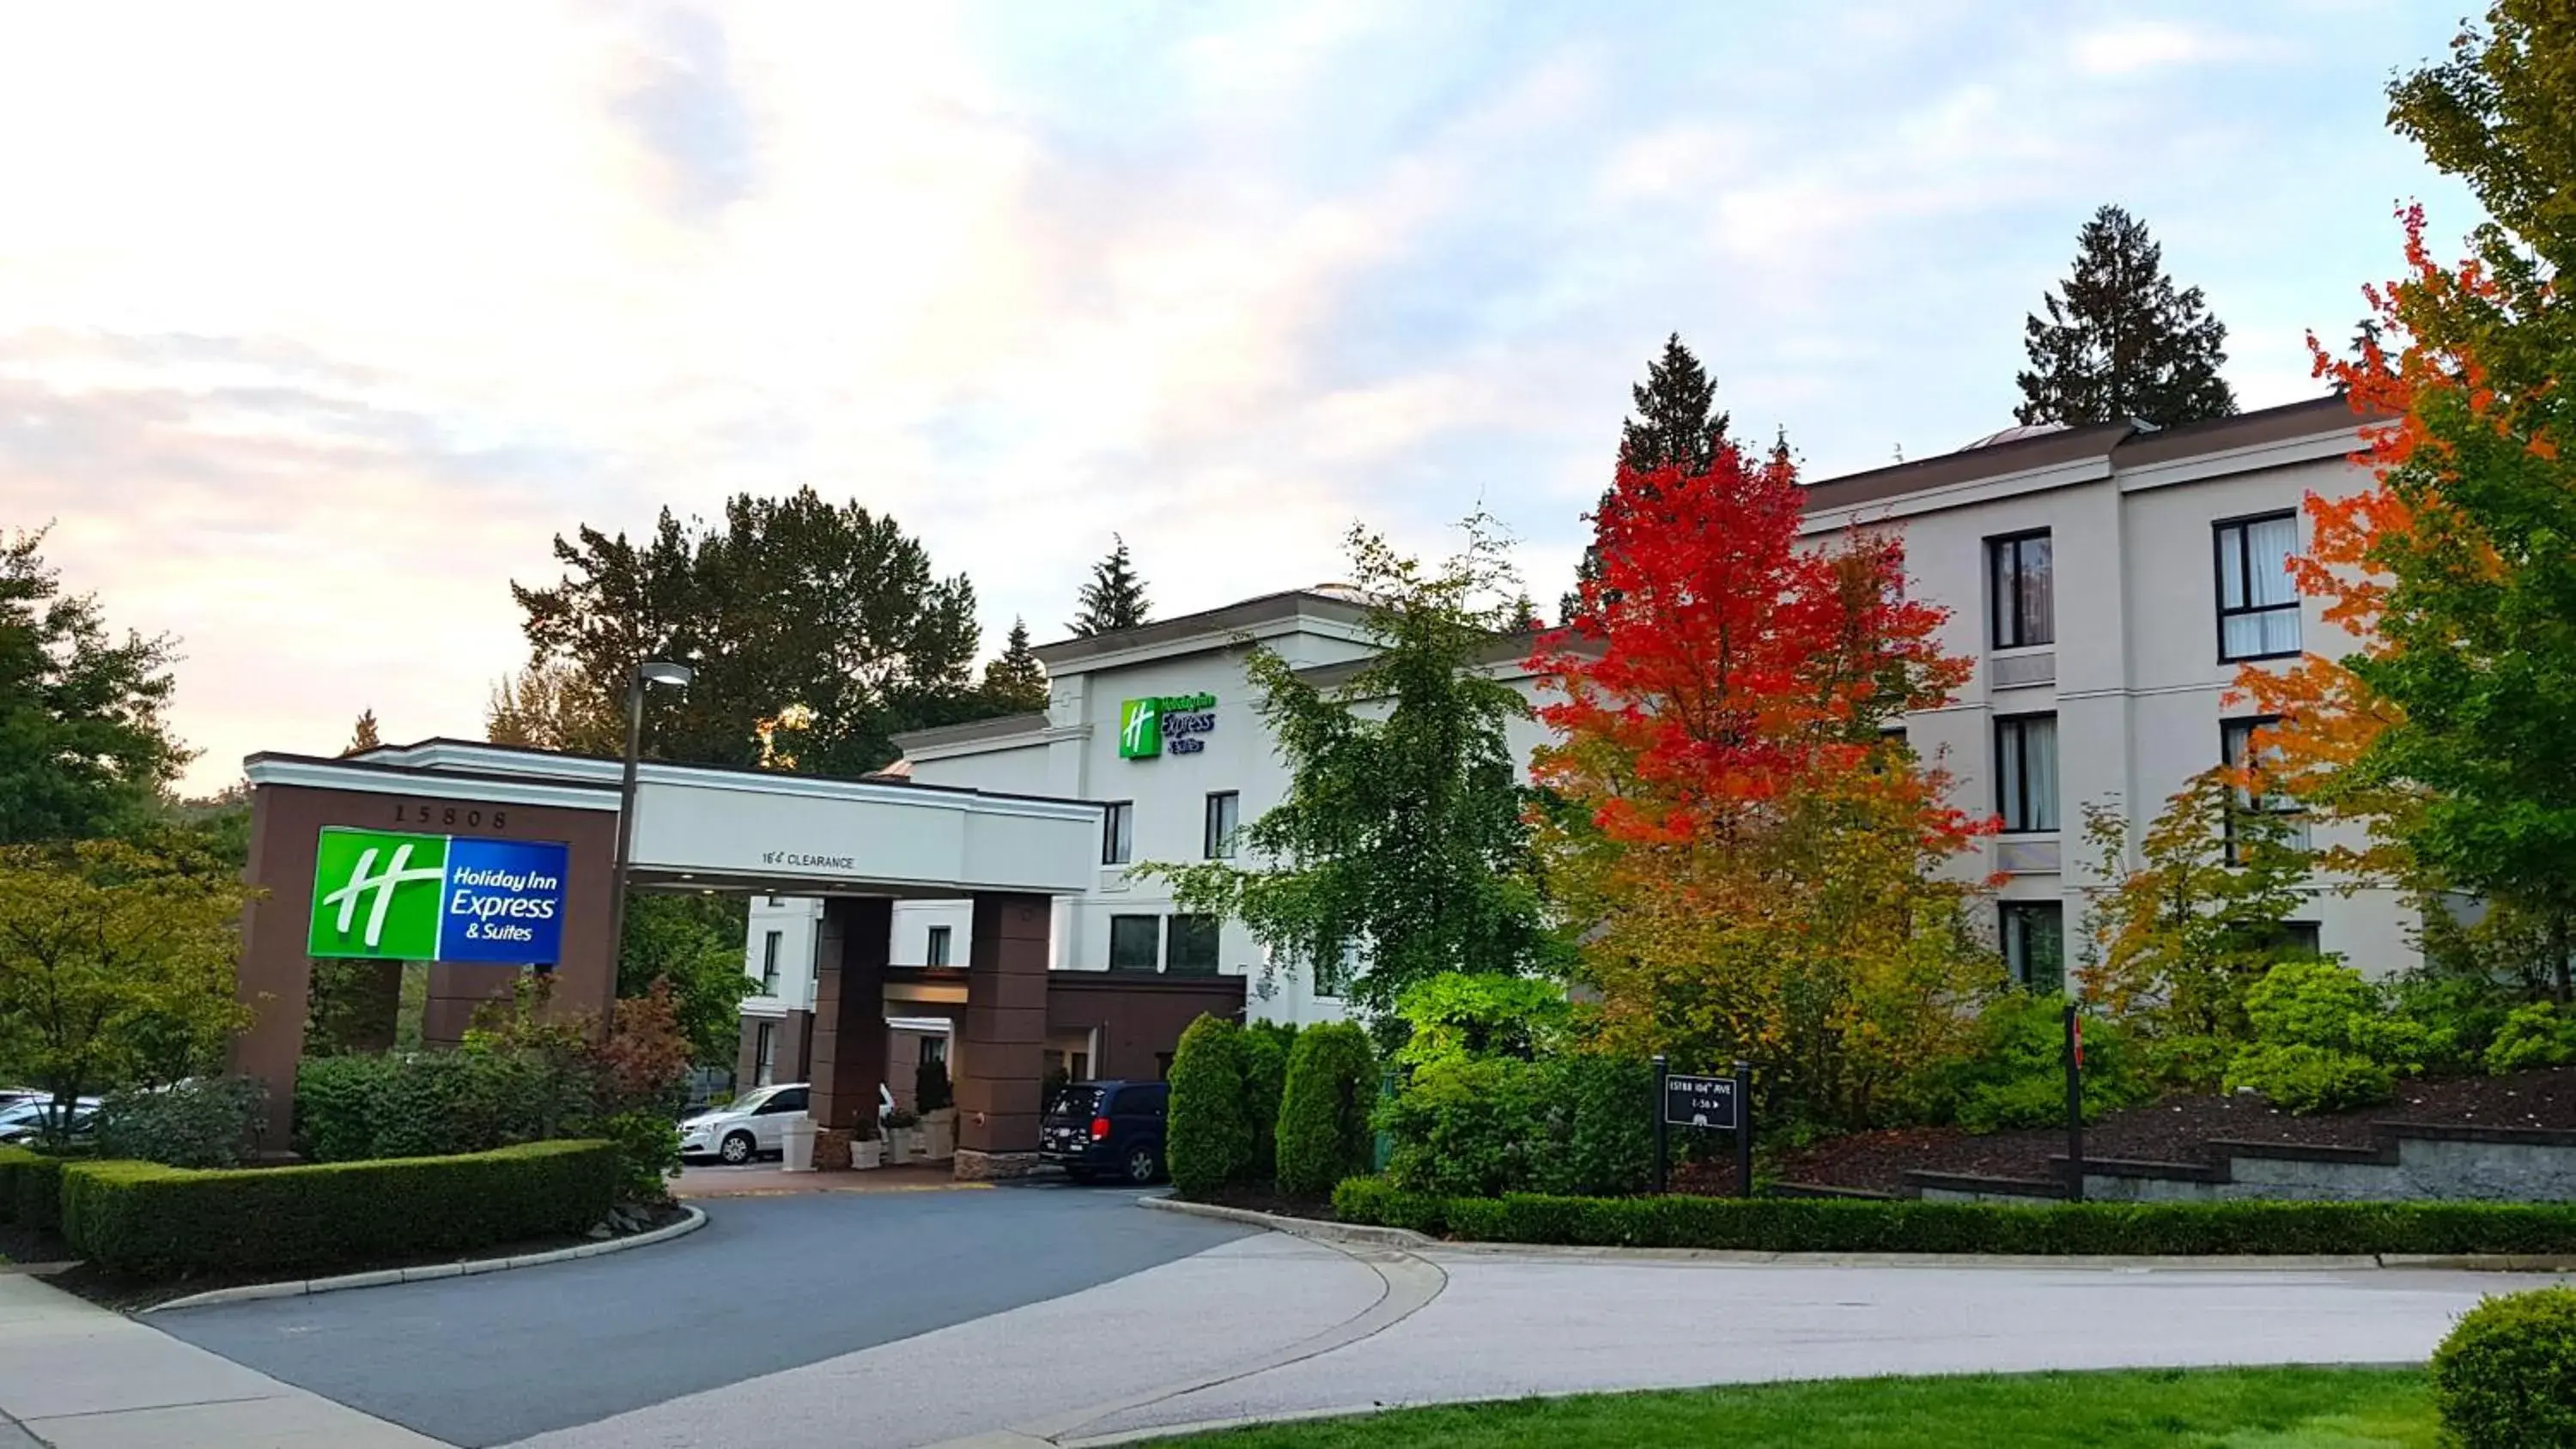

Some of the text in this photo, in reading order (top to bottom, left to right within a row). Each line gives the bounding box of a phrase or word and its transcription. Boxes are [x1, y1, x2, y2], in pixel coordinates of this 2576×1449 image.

[1161, 712, 1215, 738] Express
[395, 804, 507, 829] 15808
[787, 854, 854, 870] CLEARANCE
[453, 866, 557, 892] Holiday Inn
[451, 889, 555, 922] Express
[466, 923, 532, 942] & Suites
[1713, 1084, 1731, 1095] AVE
